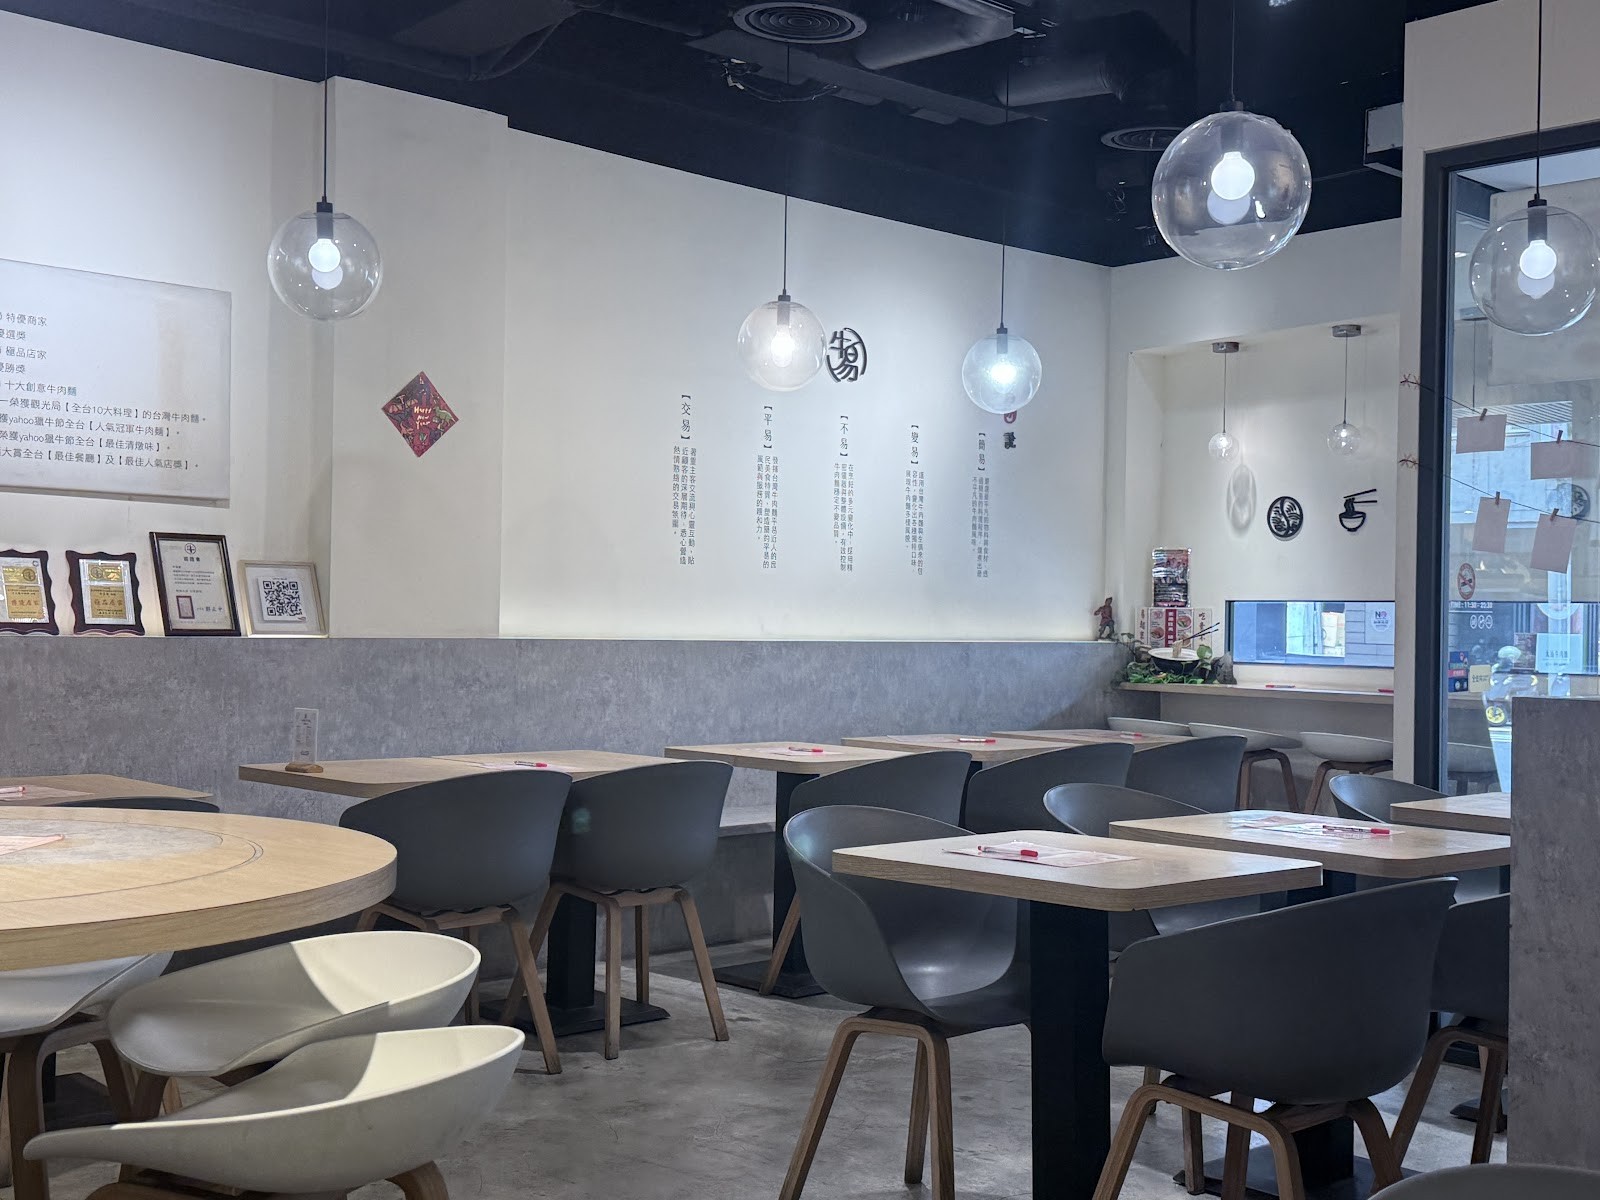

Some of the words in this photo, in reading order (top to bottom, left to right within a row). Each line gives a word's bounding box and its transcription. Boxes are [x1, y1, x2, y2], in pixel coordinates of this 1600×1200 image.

[6, 312, 47, 326] 特優商家
[5, 346, 47, 360] 極品店家
[4, 380, 77, 396] 十大創意牛肉麵
